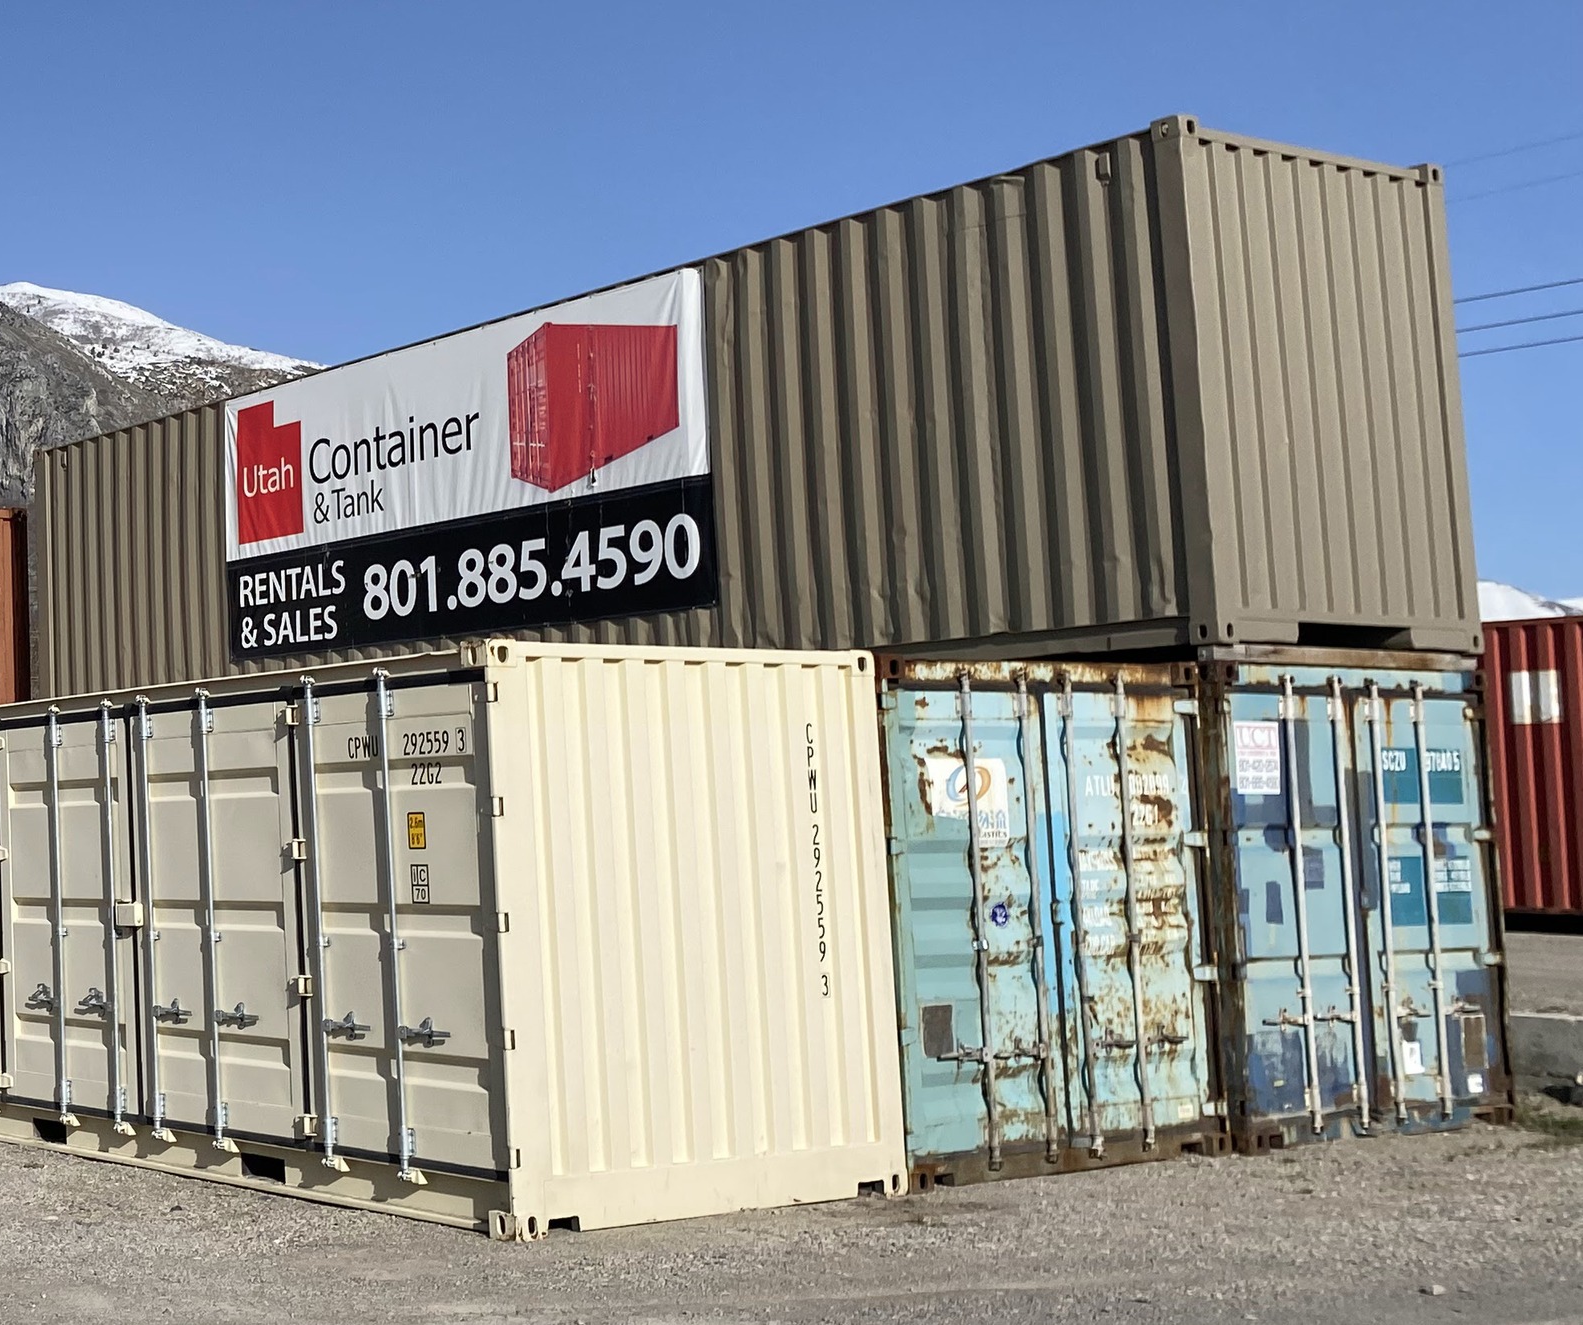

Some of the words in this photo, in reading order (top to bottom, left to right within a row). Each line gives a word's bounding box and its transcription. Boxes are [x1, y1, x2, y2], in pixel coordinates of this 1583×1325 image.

[309, 412, 480, 484] Container
[243, 456, 294, 498] Utah
[313, 493, 330, 524] &
[331, 482, 384, 521] Tank
[239, 560, 345, 607] RENTALS
[363, 514, 700, 620] 801.885.4590
[241, 617, 258, 648] &
[263, 605, 338, 645] SALES
[347, 735, 379, 759] CPWU
[403, 730, 449, 756] 292559
[457, 729, 465, 751] 3
[411, 762, 442, 785] 22G2
[806, 723, 817, 814] CPWU
[812, 824, 826, 962] 292559
[822, 975, 829, 996] 3
